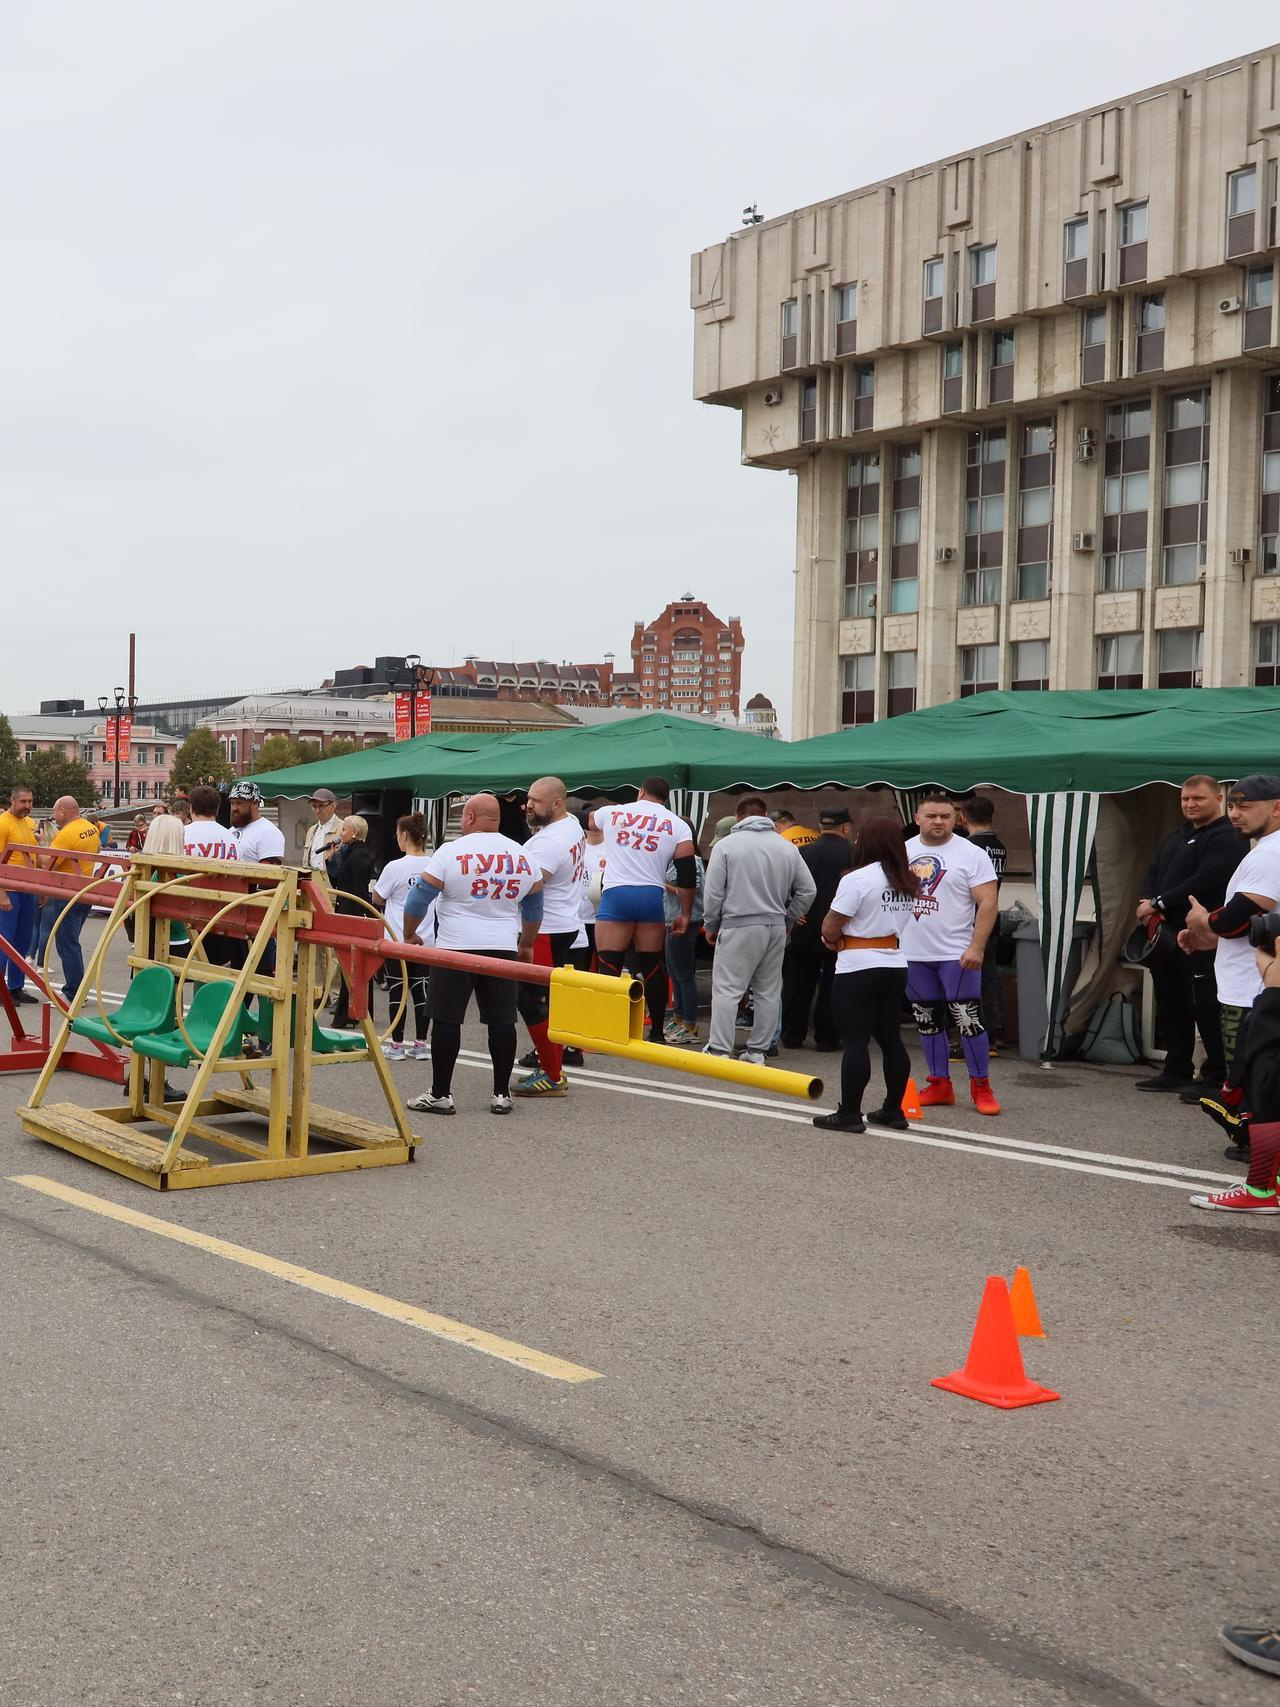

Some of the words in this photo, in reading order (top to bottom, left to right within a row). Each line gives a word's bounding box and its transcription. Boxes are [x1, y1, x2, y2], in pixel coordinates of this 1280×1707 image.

[611, 811, 673, 836] ТУЛА
[184, 839, 238, 861] ТУЛА
[616, 830, 660, 852] 875
[791, 836, 820, 845] СУДЬ
[456, 851, 532, 876] ТУЛА
[471, 877, 521, 900] 875
